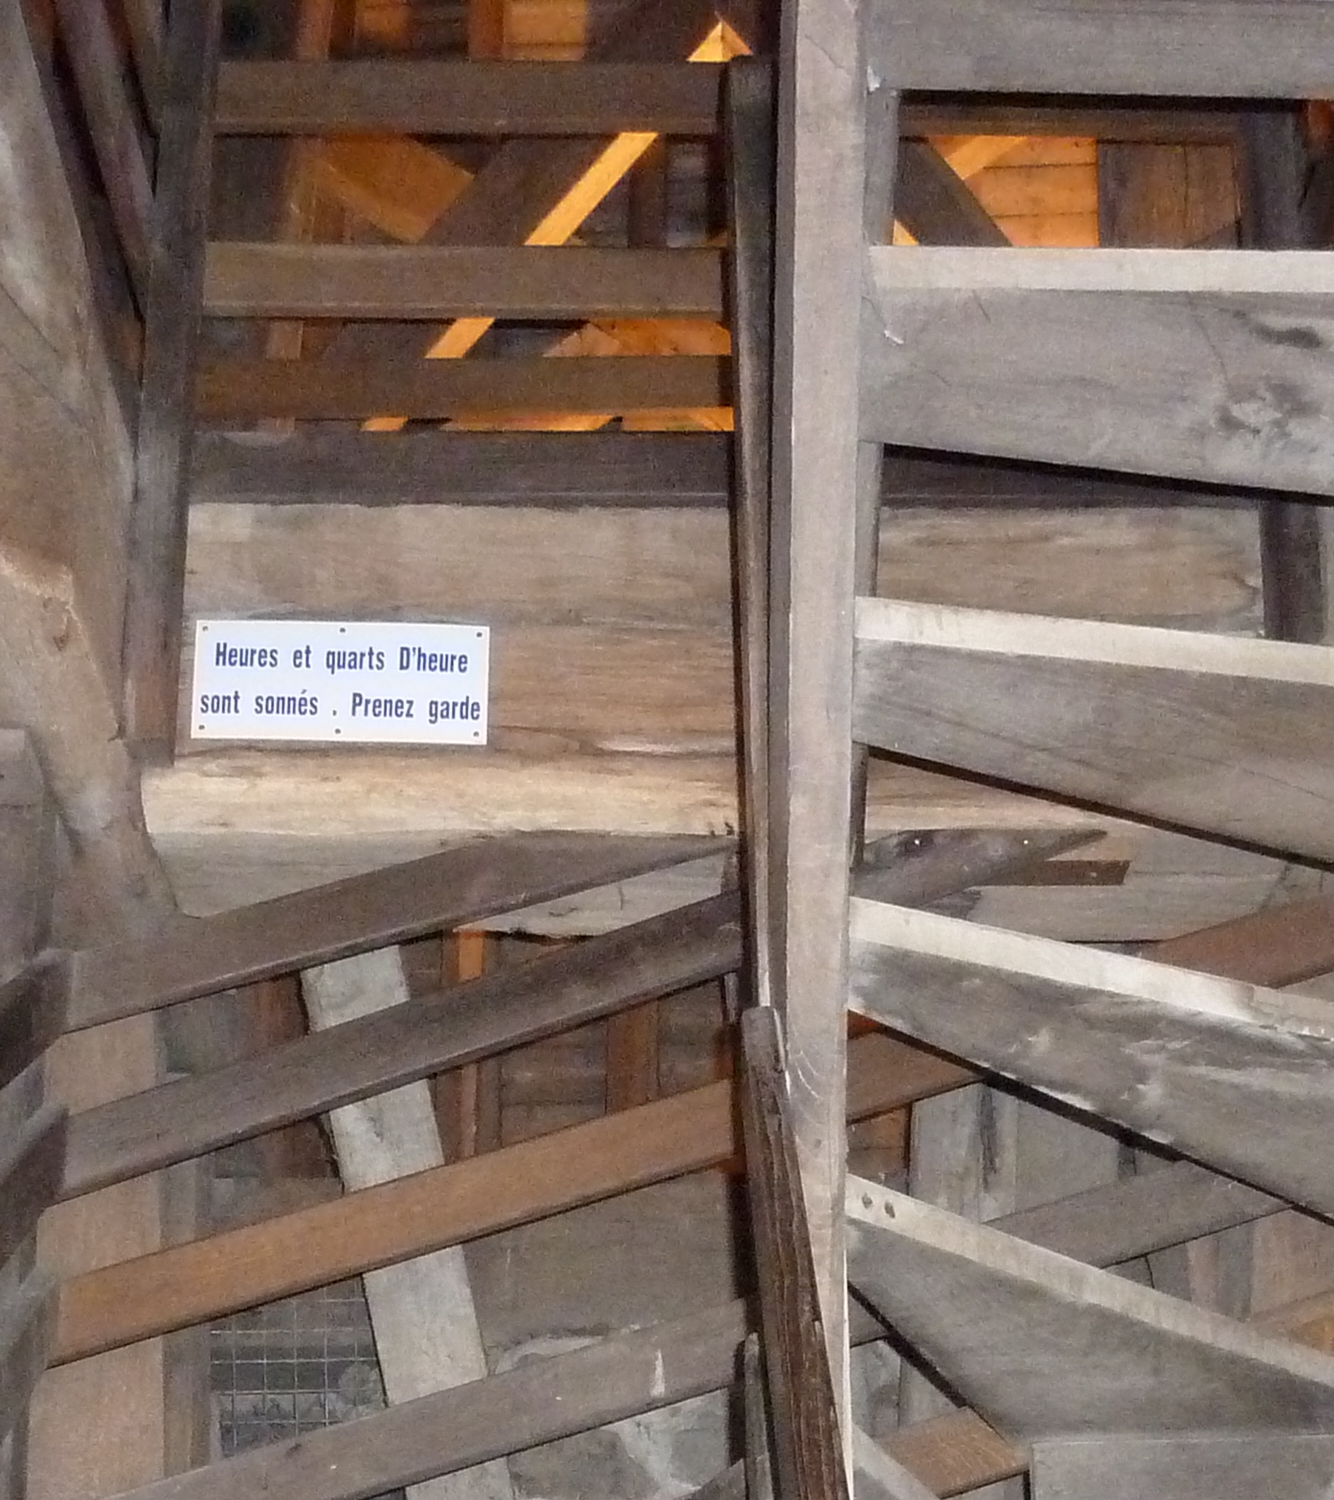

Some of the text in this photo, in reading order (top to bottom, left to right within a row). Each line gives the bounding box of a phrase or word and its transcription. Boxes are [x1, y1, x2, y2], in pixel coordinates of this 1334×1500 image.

[215, 642, 469, 675] Heures et quarts D'heure
[200, 690, 240, 714] sont
[254, 689, 318, 716] sonnés
[351, 692, 415, 719] Prenez
[428, 695, 481, 724] garde
